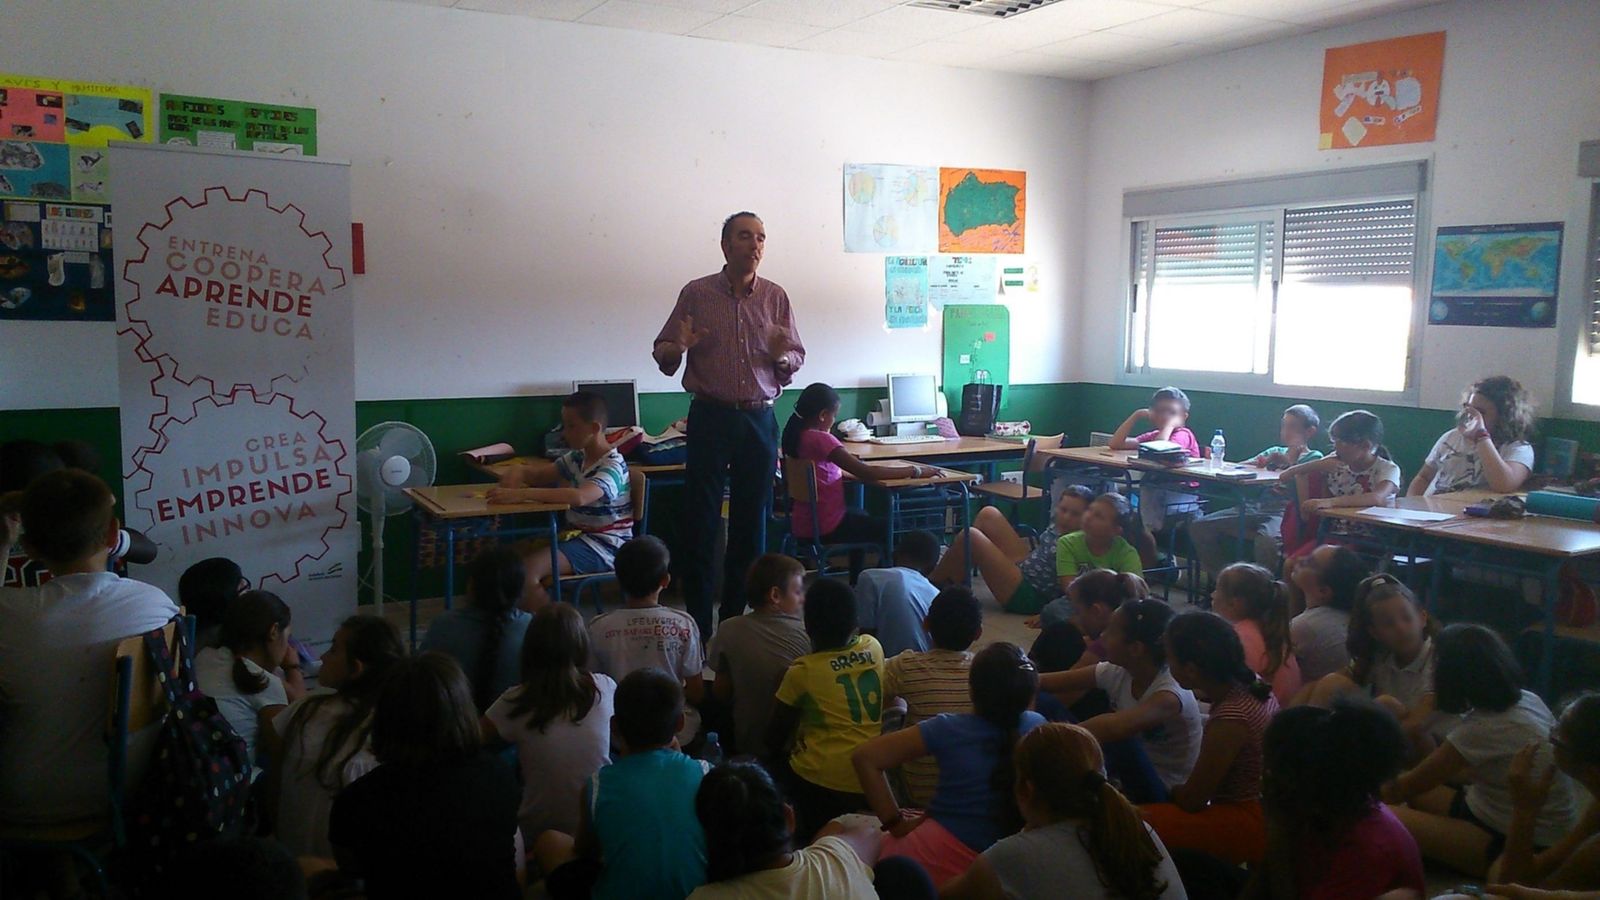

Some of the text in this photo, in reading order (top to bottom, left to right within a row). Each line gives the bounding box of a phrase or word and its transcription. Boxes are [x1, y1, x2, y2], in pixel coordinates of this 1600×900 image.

[168, 236, 269, 266] ENTRENA
[155, 273, 313, 318] APRENDE
[166, 252, 327, 296] COOPERA
[206, 307, 314, 341] EDUCA
[245, 431, 307, 452] CREA
[182, 444, 333, 488] IMPULSA
[156, 468, 332, 522] EMPRENDE
[181, 501, 317, 545] INNOVA
[830, 651, 876, 671] BRASIL
[836, 669, 882, 725] 10
